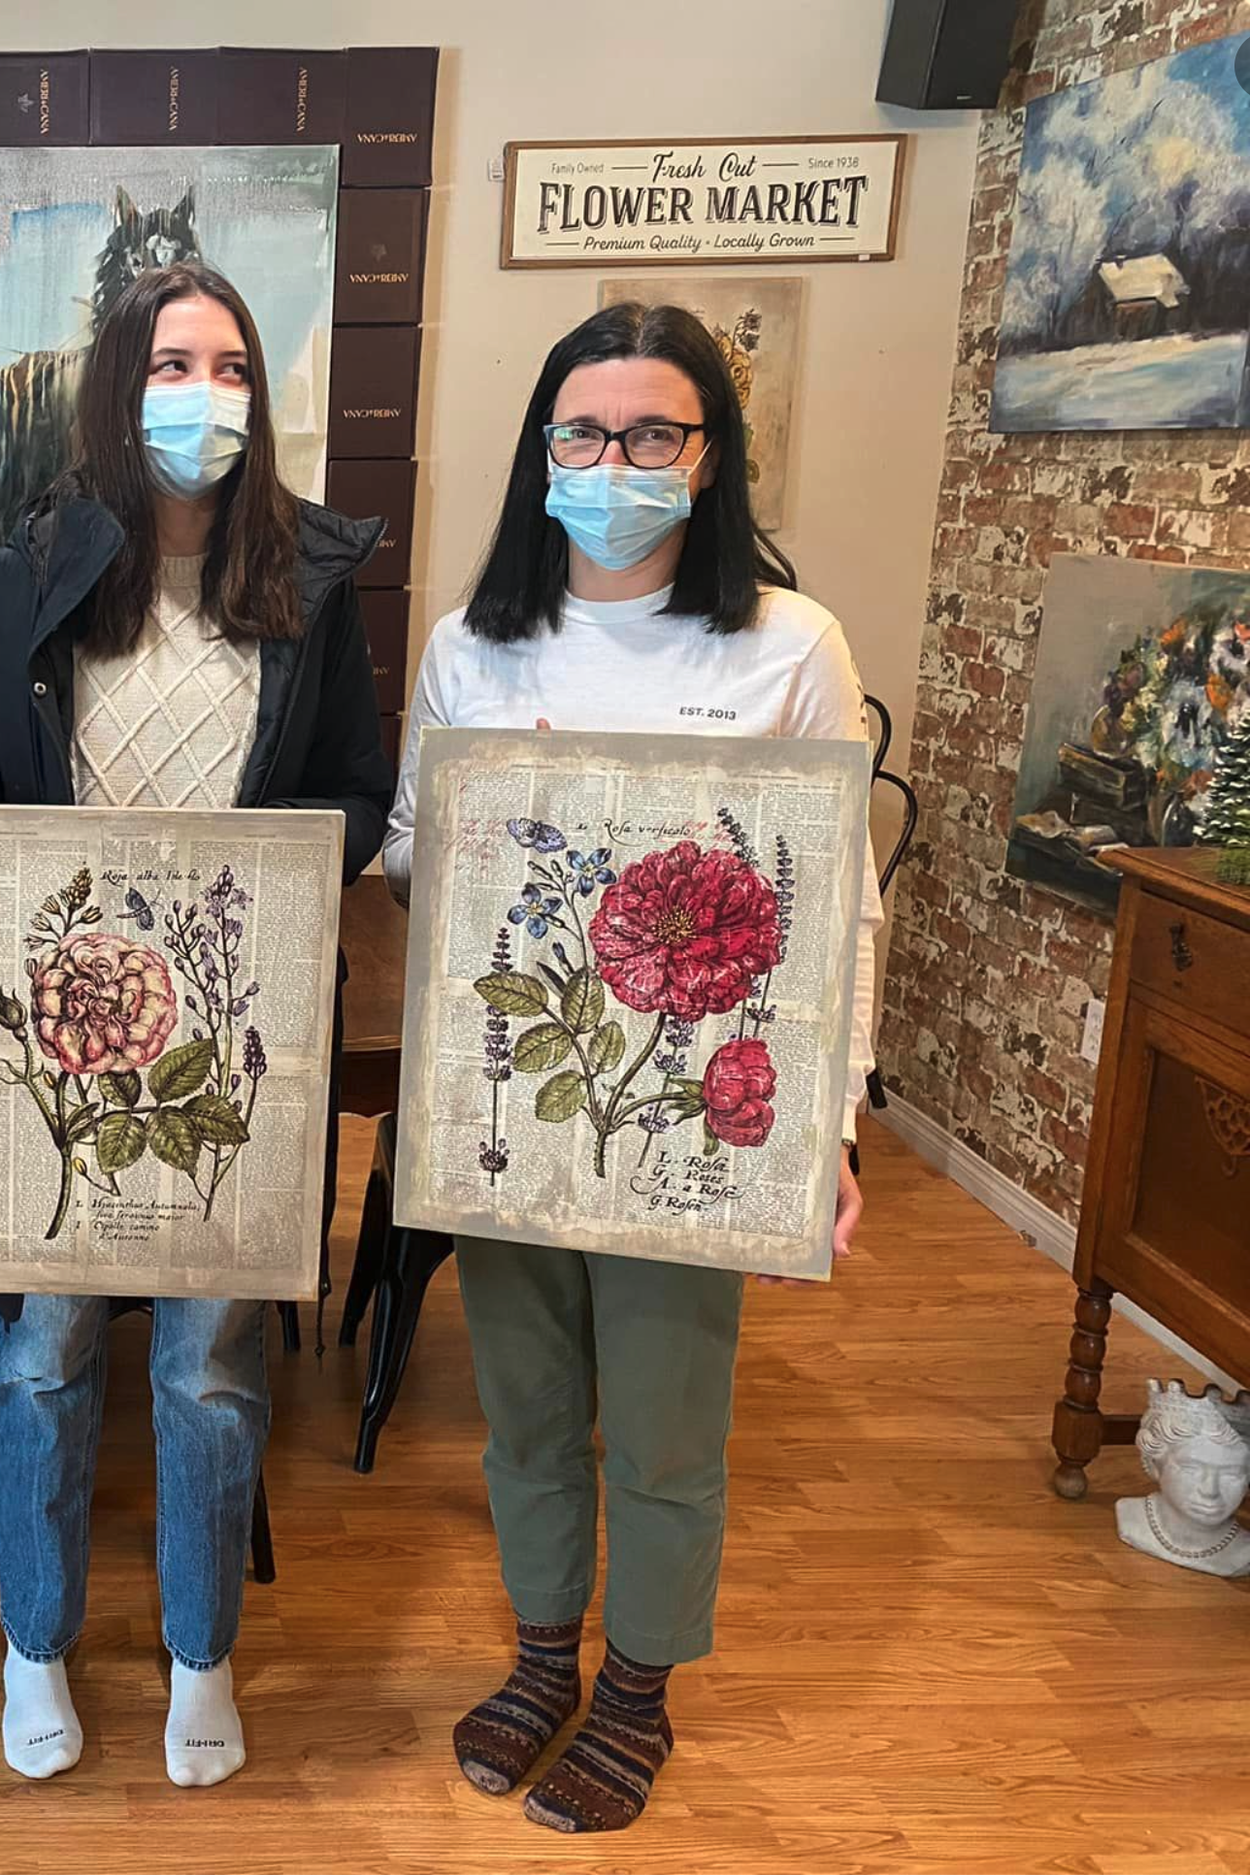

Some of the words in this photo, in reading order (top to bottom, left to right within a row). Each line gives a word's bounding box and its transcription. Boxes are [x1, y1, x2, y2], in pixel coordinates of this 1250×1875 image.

[551, 163, 575, 175] Family
[577, 162, 604, 173] Owned
[653, 151, 706, 183] Fresh
[718, 152, 757, 182] Cut
[808, 157, 834, 169] Since
[836, 156, 860, 168] 1938
[537, 181, 694, 235] FLOWER
[705, 175, 870, 229] MARKET
[583, 236, 645, 251] Premium
[649, 233, 702, 252] Quality
[713, 233, 765, 251] Locally
[769, 232, 815, 248] Grown
[679, 706, 704, 716] EST.
[707, 708, 736, 720] 2013
[185, 1738, 225, 1748] DRI-FIT
